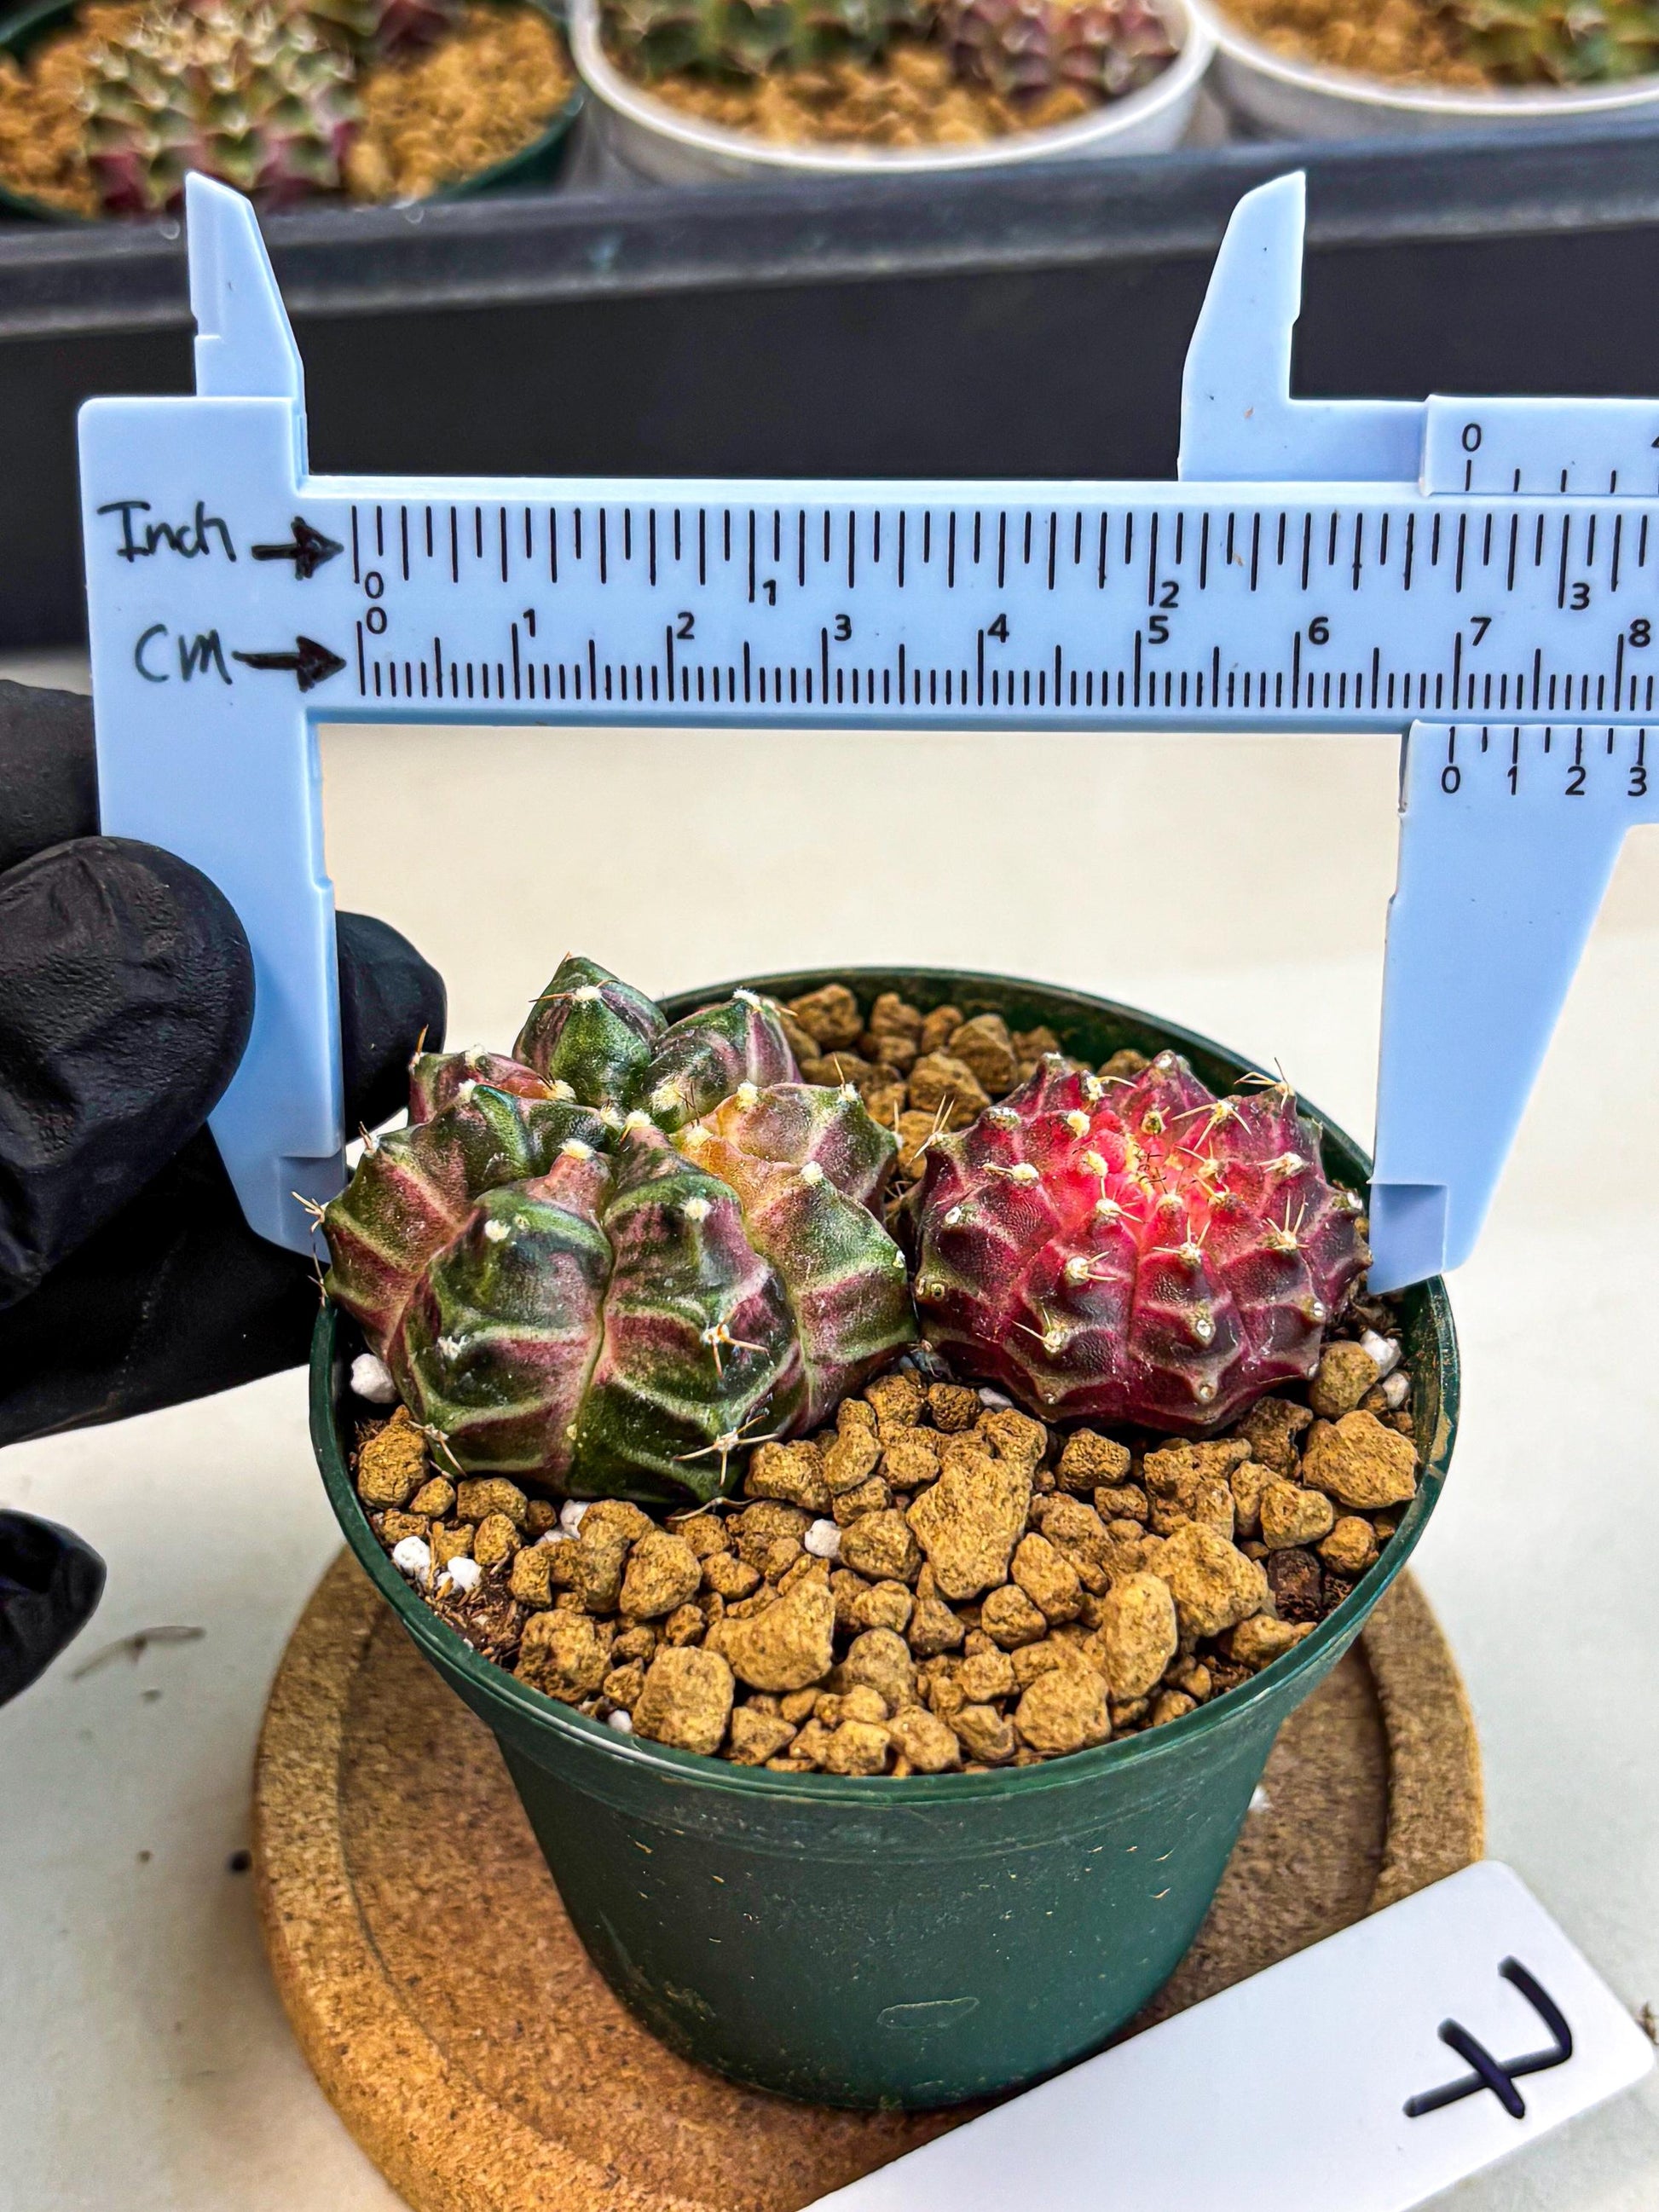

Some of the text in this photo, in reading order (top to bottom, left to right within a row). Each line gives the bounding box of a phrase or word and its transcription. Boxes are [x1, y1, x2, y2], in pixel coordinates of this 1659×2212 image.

[1461, 423, 1482, 453] 0
[96, 500, 237, 563] Inch
[364, 571, 1591, 611] 0 1 2 3
[366, 606, 1651, 649] 0 1 2 3 4 5 6 7 8
[1441, 765, 1648, 797] 0 1 2 3
